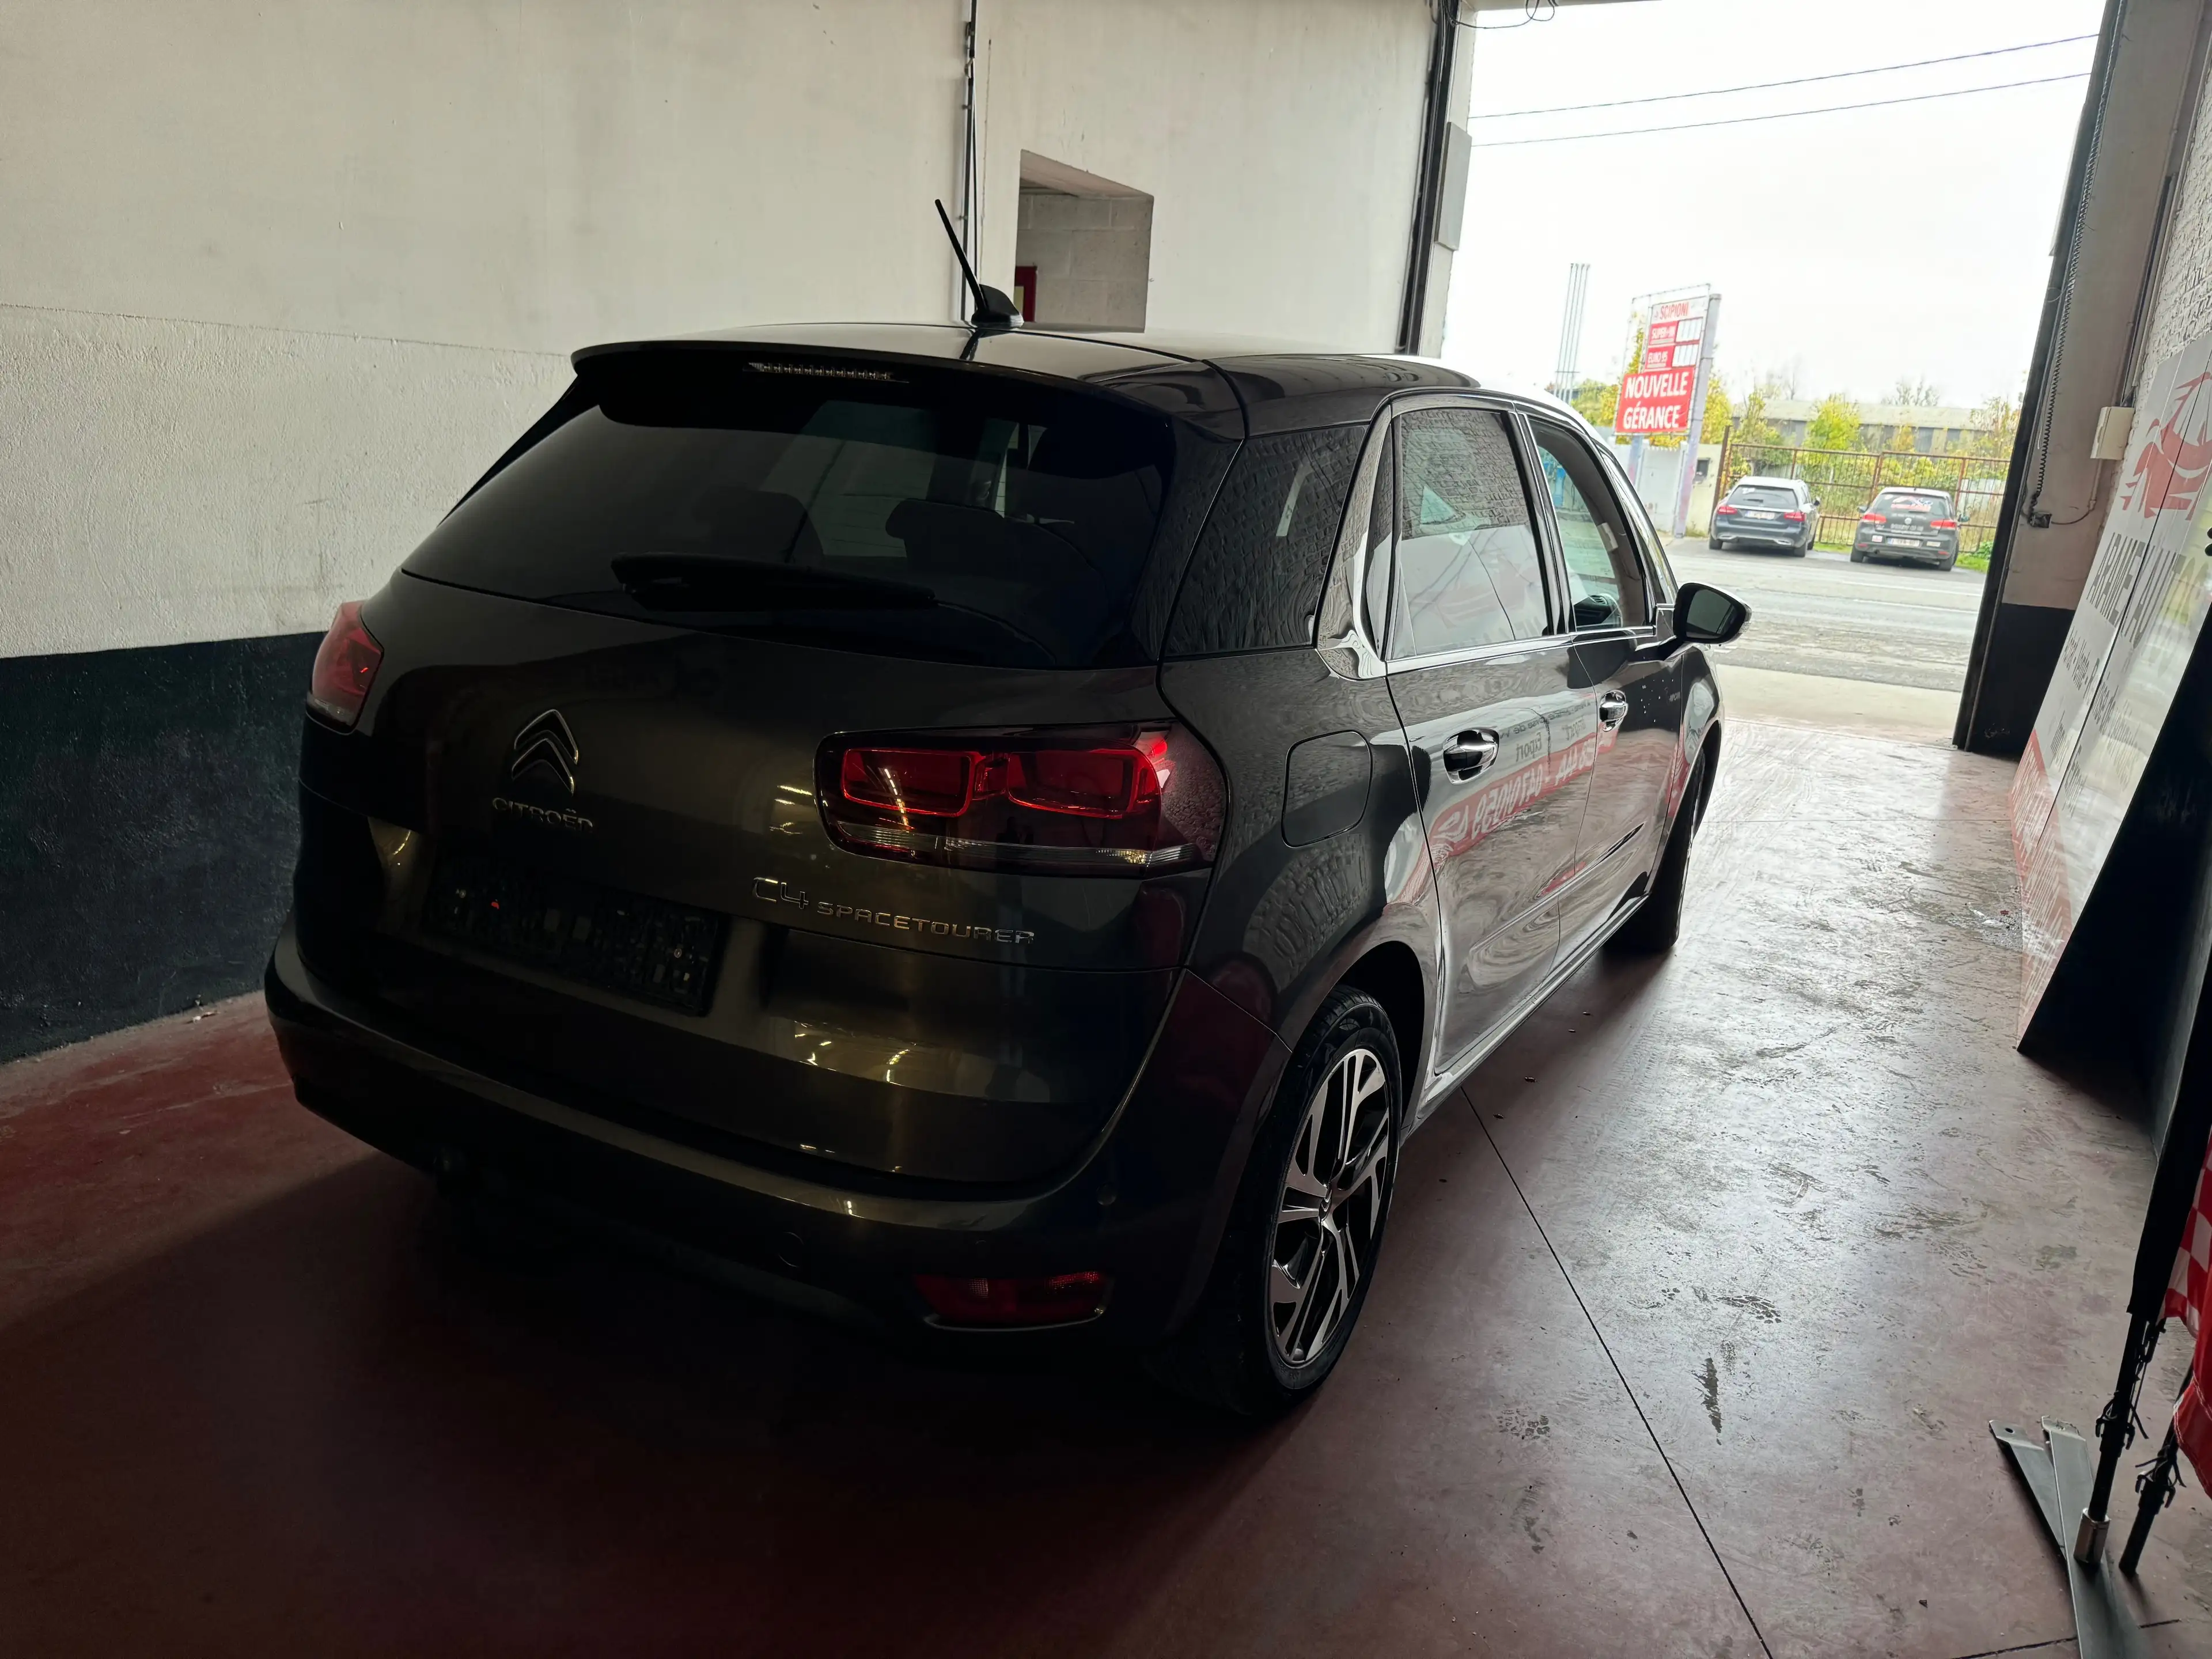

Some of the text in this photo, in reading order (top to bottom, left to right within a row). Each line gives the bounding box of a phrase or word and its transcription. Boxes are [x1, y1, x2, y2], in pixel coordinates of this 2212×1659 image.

[1660, 302, 1689, 319] SCIPIONI
[1624, 372, 1690, 399] NOUVELLE
[1623, 401, 1681, 429] GÉRANCE
[492, 797, 593, 834] CITROËN
[752, 877, 1035, 944] C4 SPACETOURER
